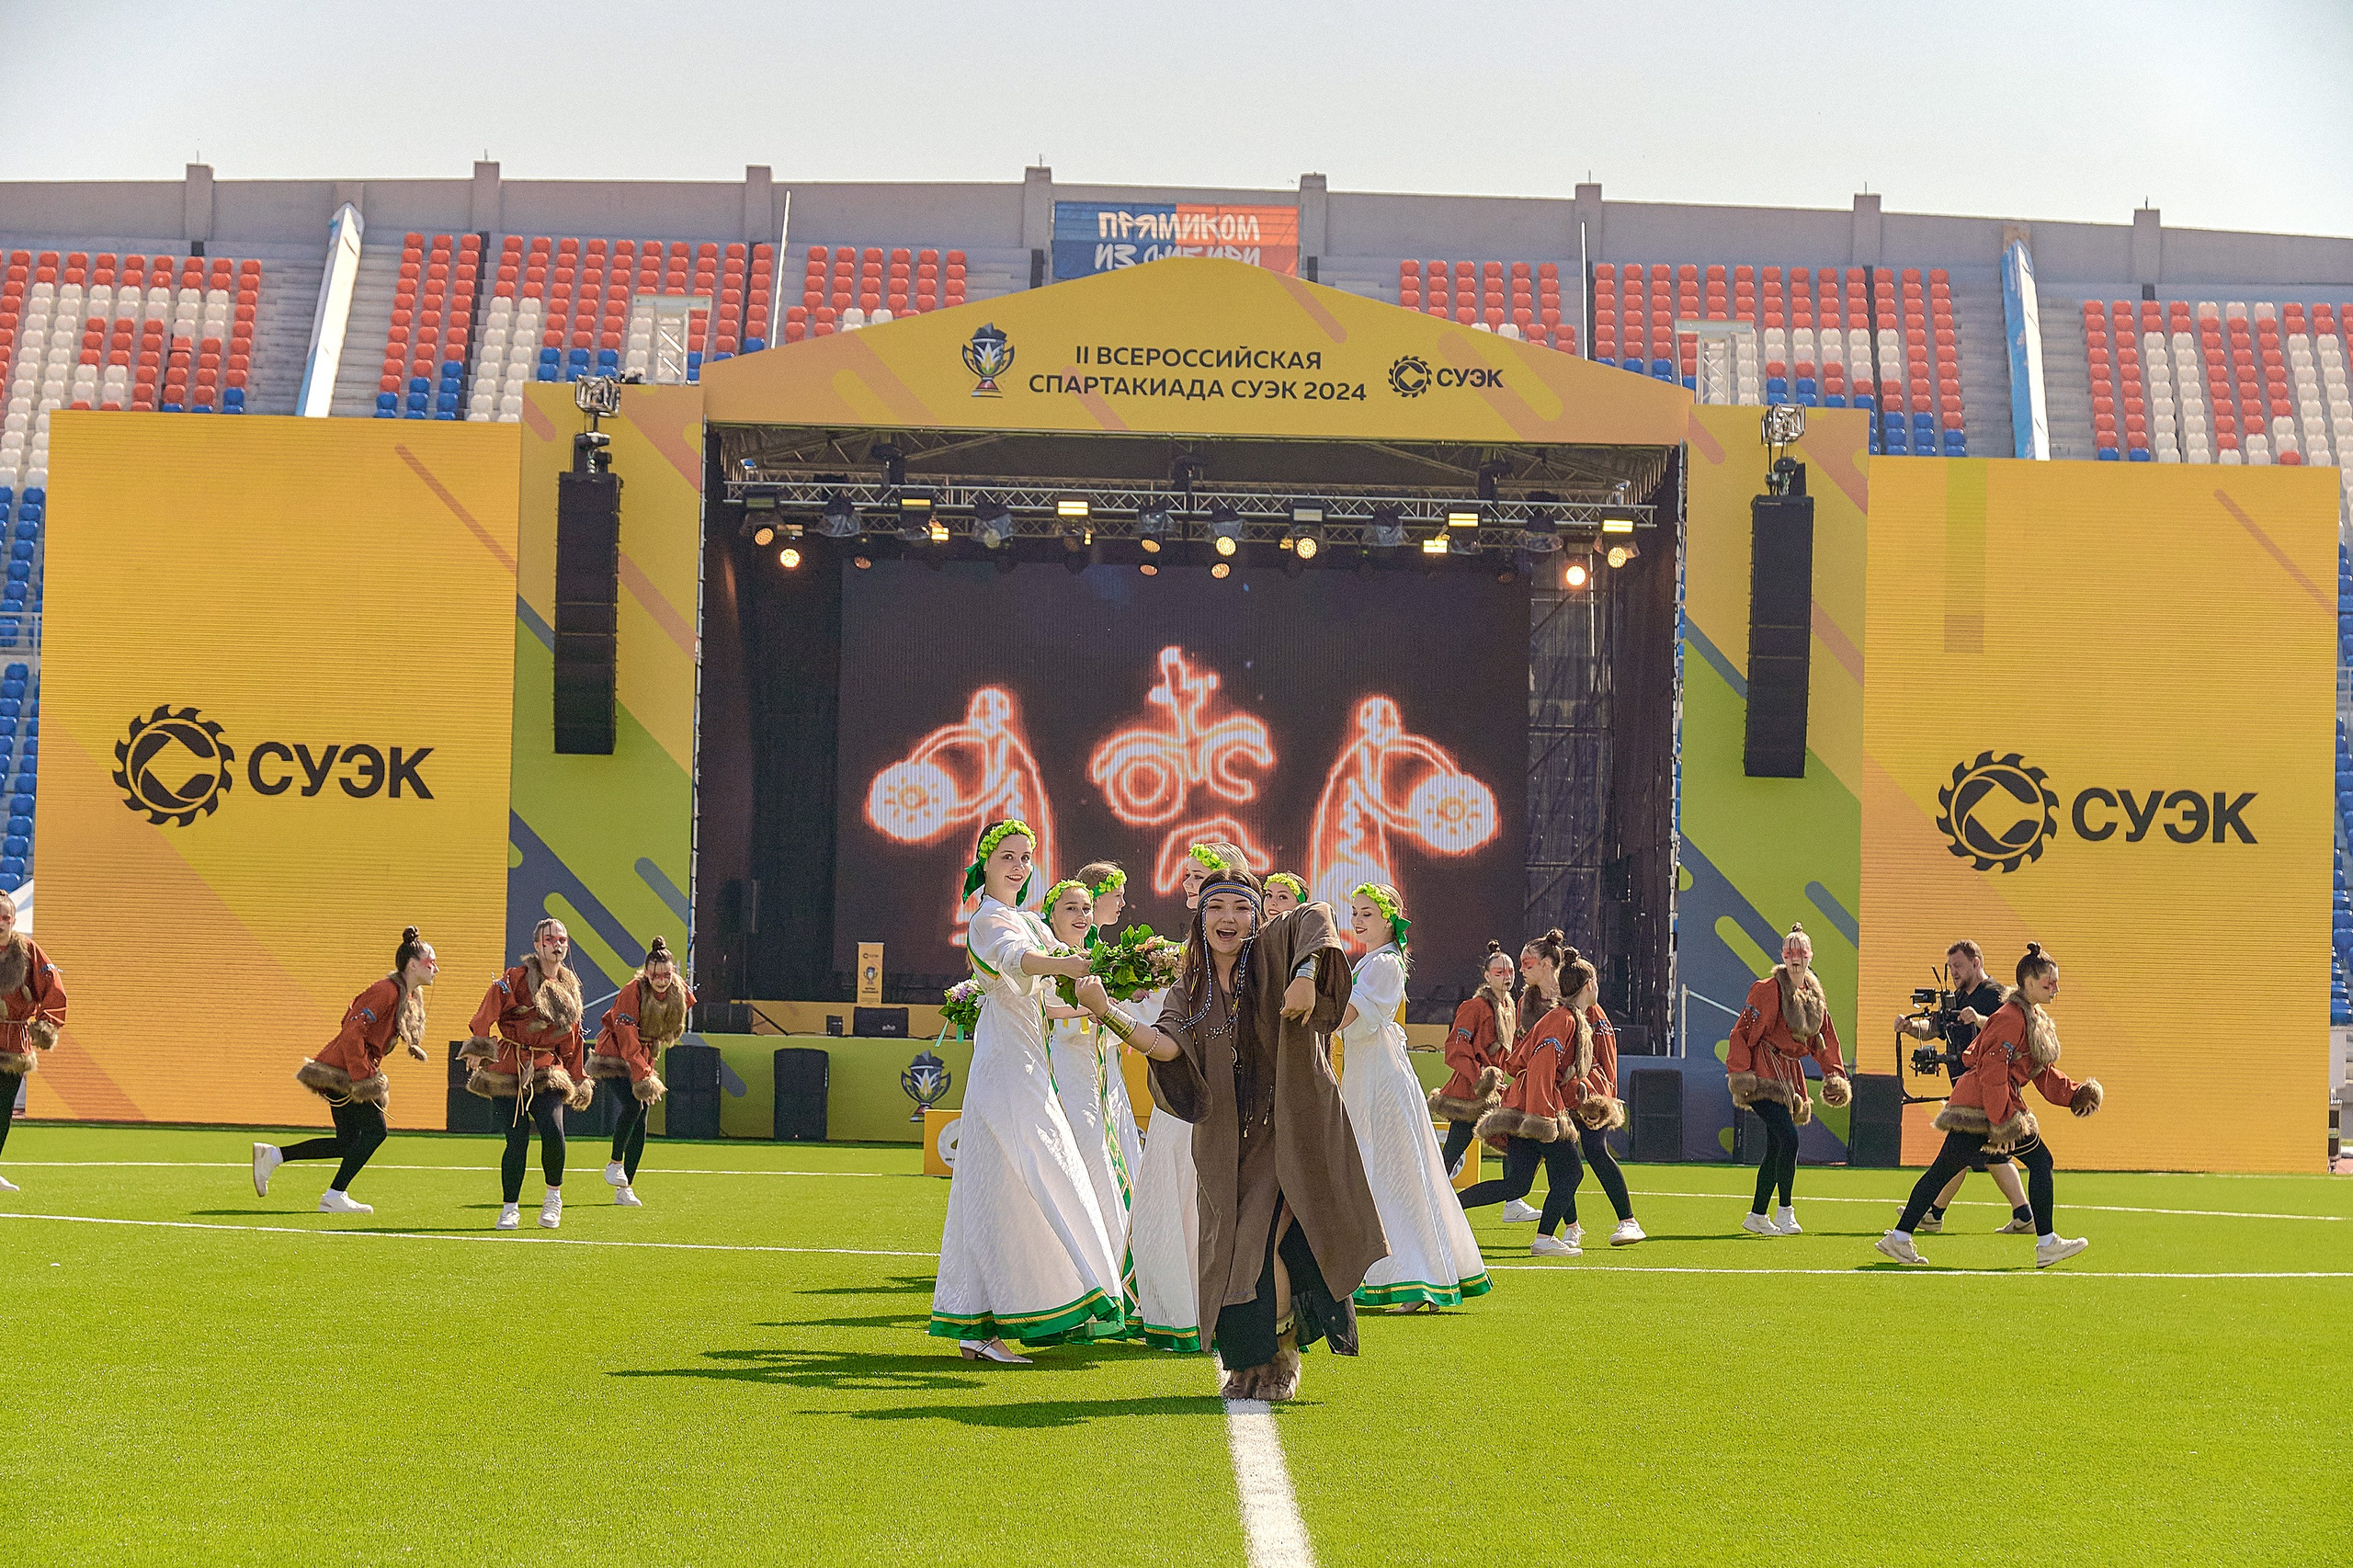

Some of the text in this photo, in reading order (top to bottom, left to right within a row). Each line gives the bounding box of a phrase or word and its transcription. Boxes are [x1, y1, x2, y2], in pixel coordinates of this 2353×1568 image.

[1097, 210, 1260, 241] ПРЯМИКОМ
[1095, 243, 1137, 270] ИЗ
[1076, 346, 1321, 369] II ВСЕРОССИЙСКАЯ
[1029, 374, 1367, 402] СПАРТАКИАДА СУЭК 2024
[1437, 368, 1504, 388] СУЭК
[247, 741, 435, 800] СУЭК
[2072, 788, 2258, 844] СУЭК
